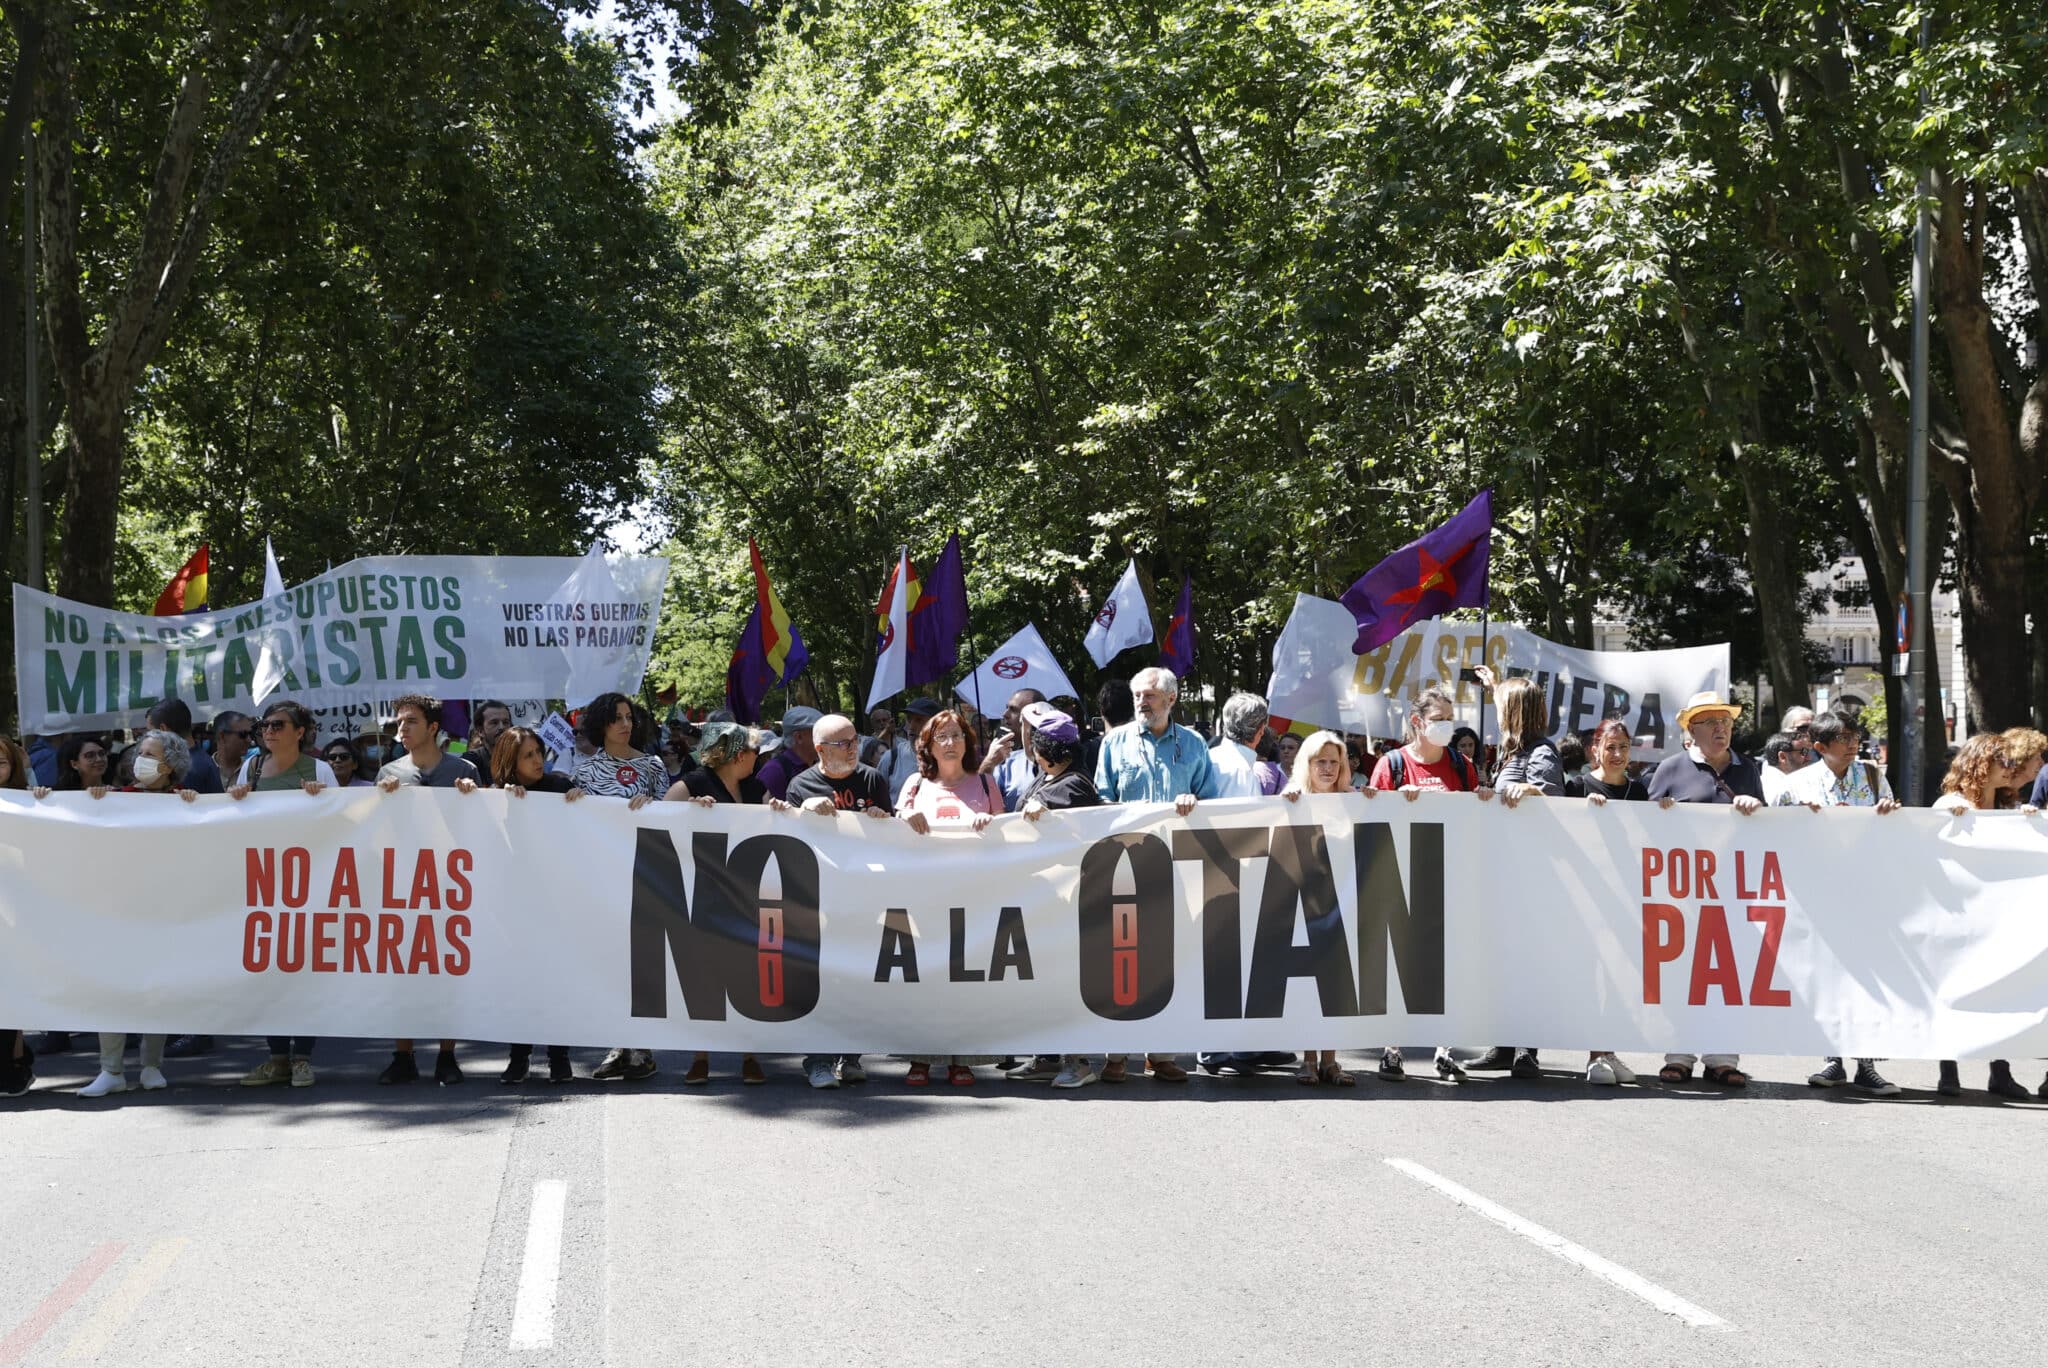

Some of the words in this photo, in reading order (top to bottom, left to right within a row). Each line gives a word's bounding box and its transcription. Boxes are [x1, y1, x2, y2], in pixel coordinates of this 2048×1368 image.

[45, 606, 89, 644] NO
[103, 622, 126, 644] A
[136, 626, 200, 645] LOS
[503, 603, 585, 622] VUESTRAS
[591, 603, 650, 622] GUERRAS
[504, 626, 528, 648] NO
[535, 626, 569, 648] LAS
[576, 625, 647, 648] PAGAMOS
[1507, 666, 1666, 749] UERA
[833, 788, 854, 809] NO
[245, 848, 309, 908] NO
[330, 849, 360, 907] A
[384, 849, 472, 911] LAS
[1644, 848, 1717, 899] POR
[1737, 852, 1785, 900] LA
[245, 912, 471, 975] GUERRAS
[631, 827, 820, 1022] NO
[874, 909, 921, 983] A
[949, 907, 1034, 983] LA
[1079, 823, 1444, 1022] OTAN
[1644, 904, 1791, 1007] PAZ
